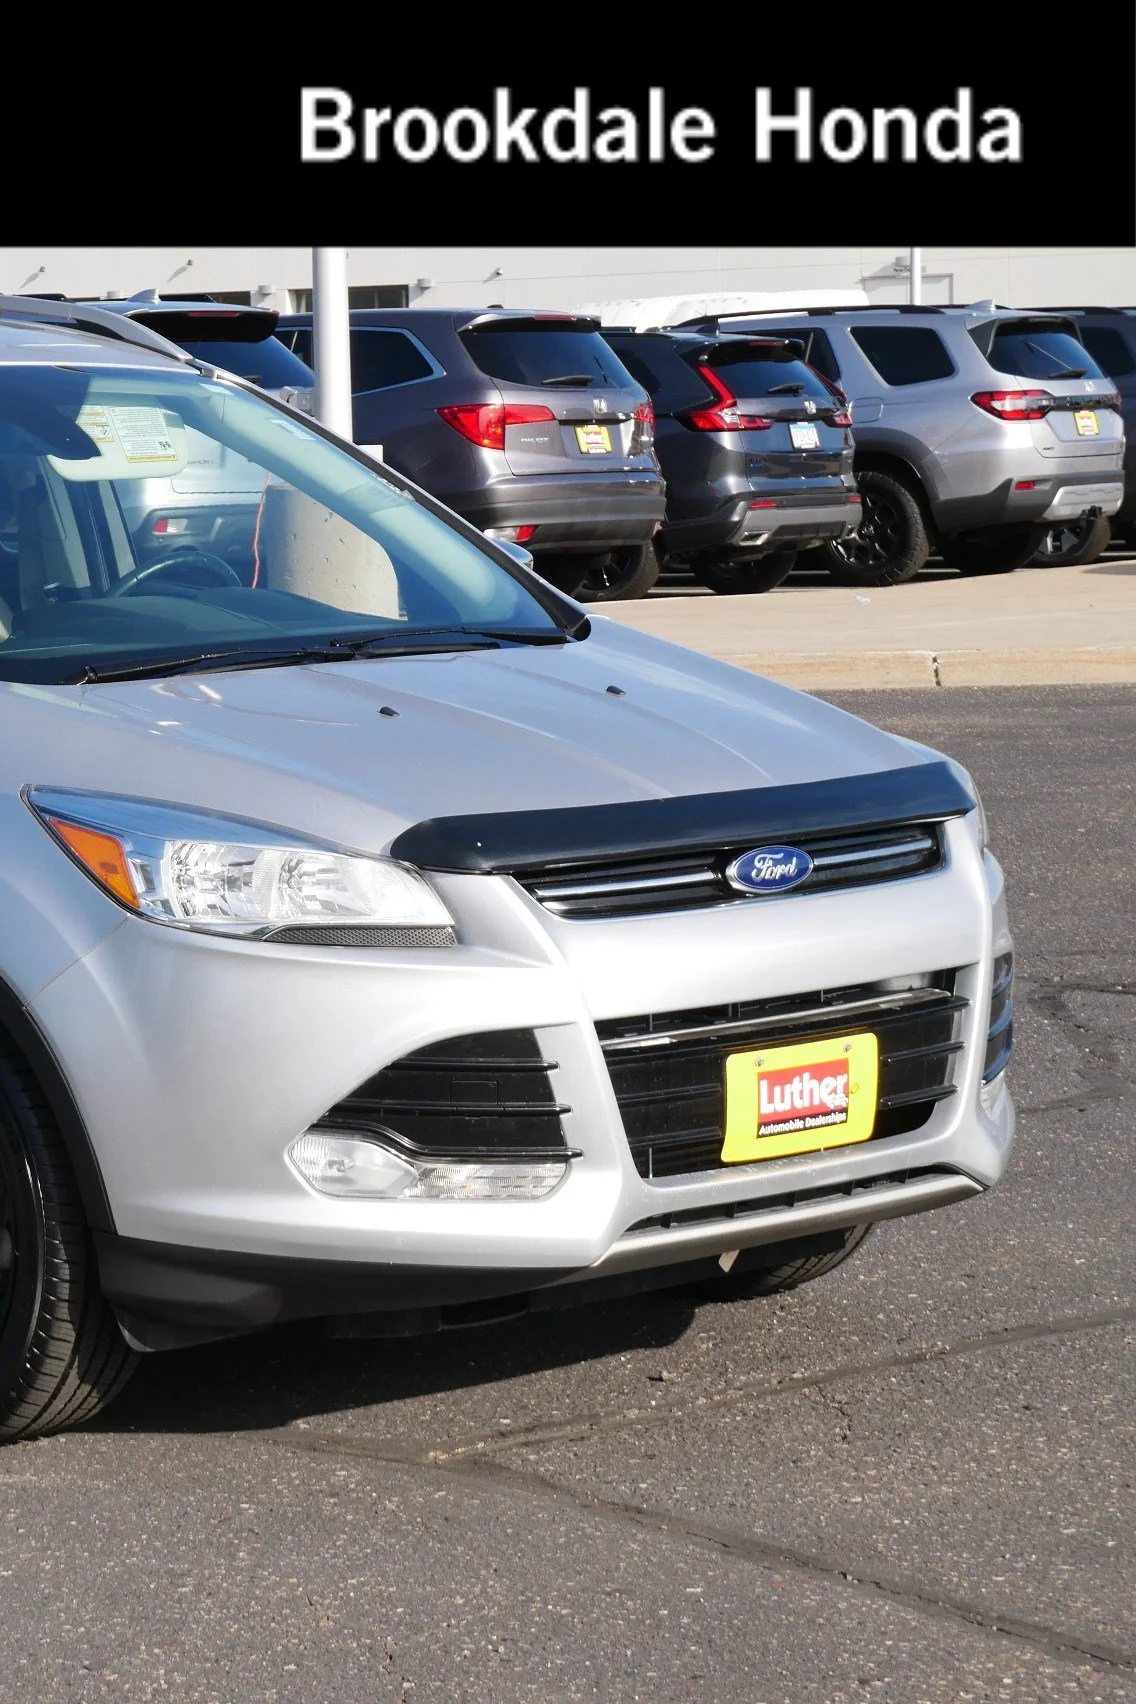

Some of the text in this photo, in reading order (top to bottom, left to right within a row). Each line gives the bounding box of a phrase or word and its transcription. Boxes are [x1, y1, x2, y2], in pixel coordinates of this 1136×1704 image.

[751, 852, 798, 883] Ford
[759, 1071, 848, 1115] Luther
[758, 1111, 847, 1136] Automobile Dealerships
